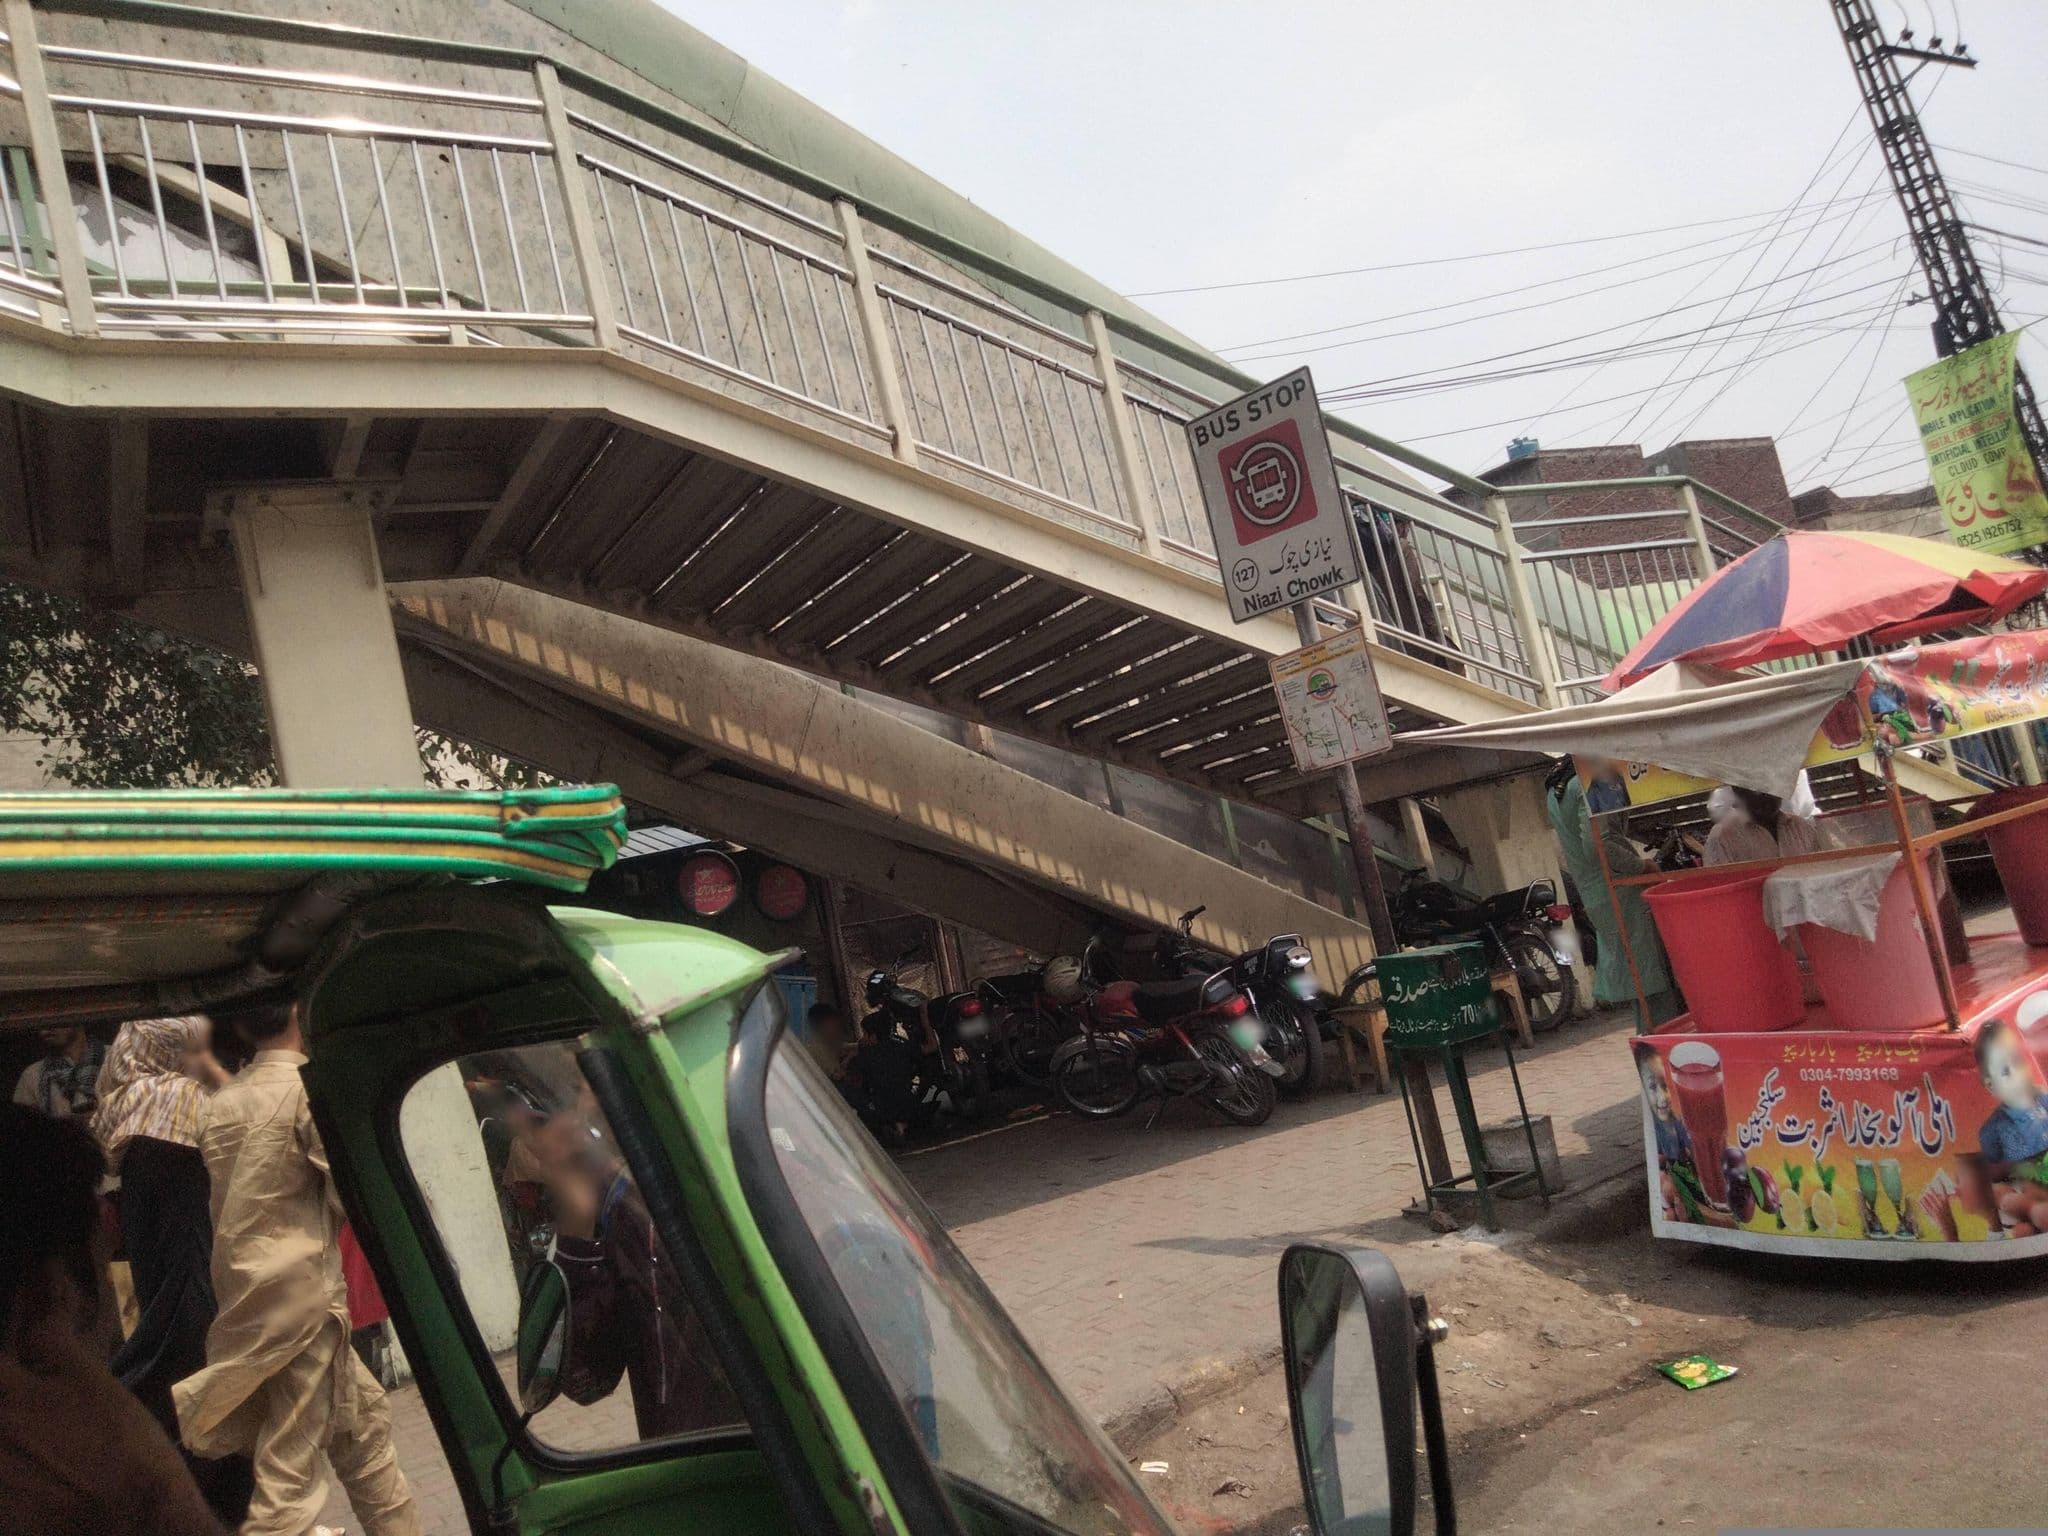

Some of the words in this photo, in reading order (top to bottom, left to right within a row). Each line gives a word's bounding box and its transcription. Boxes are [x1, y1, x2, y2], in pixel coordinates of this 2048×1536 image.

[1194, 410, 1240, 447] BUS
[1246, 378, 1306, 422] STOP
[1948, 457, 1978, 477] CLOUD
[1269, 541, 1297, 575] چوک
[1299, 537, 1331, 567] نیازی
[1234, 565, 1256, 584] 127
[1243, 586, 1282, 614] Niazi
[1287, 565, 1344, 598] Chowk
[1387, 975, 1429, 1004] صدقہ
[1799, 1067, 1899, 1081] 0304-7993168
